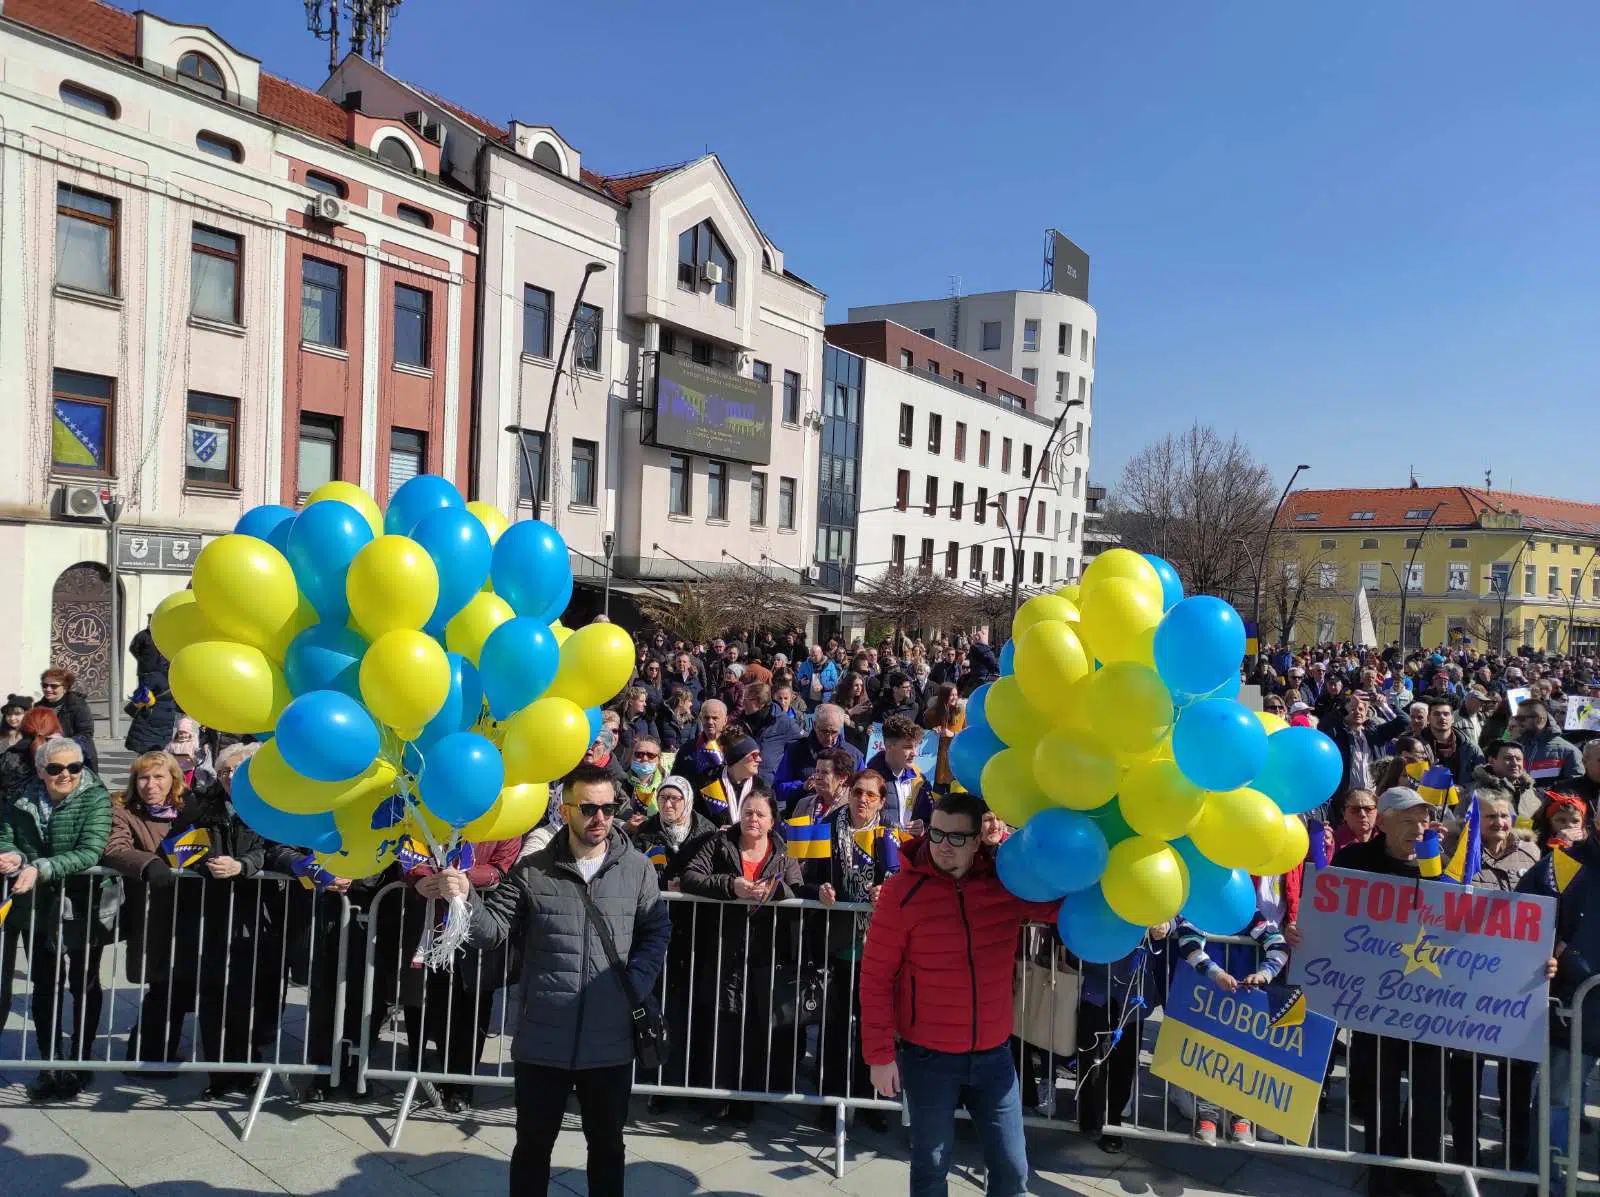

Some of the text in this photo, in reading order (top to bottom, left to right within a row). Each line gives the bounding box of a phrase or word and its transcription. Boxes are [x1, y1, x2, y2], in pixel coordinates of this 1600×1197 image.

[1313, 873, 1424, 924] STOP
[1443, 891, 1542, 943] WAR
[1343, 924, 1502, 980] Save Europe
[1189, 984, 1304, 1059] SLOBODA
[1304, 957, 1533, 1021] Save Bosnia and
[1331, 987, 1503, 1044] Herzegovina
[1179, 1037, 1294, 1114] UKRAJINI
